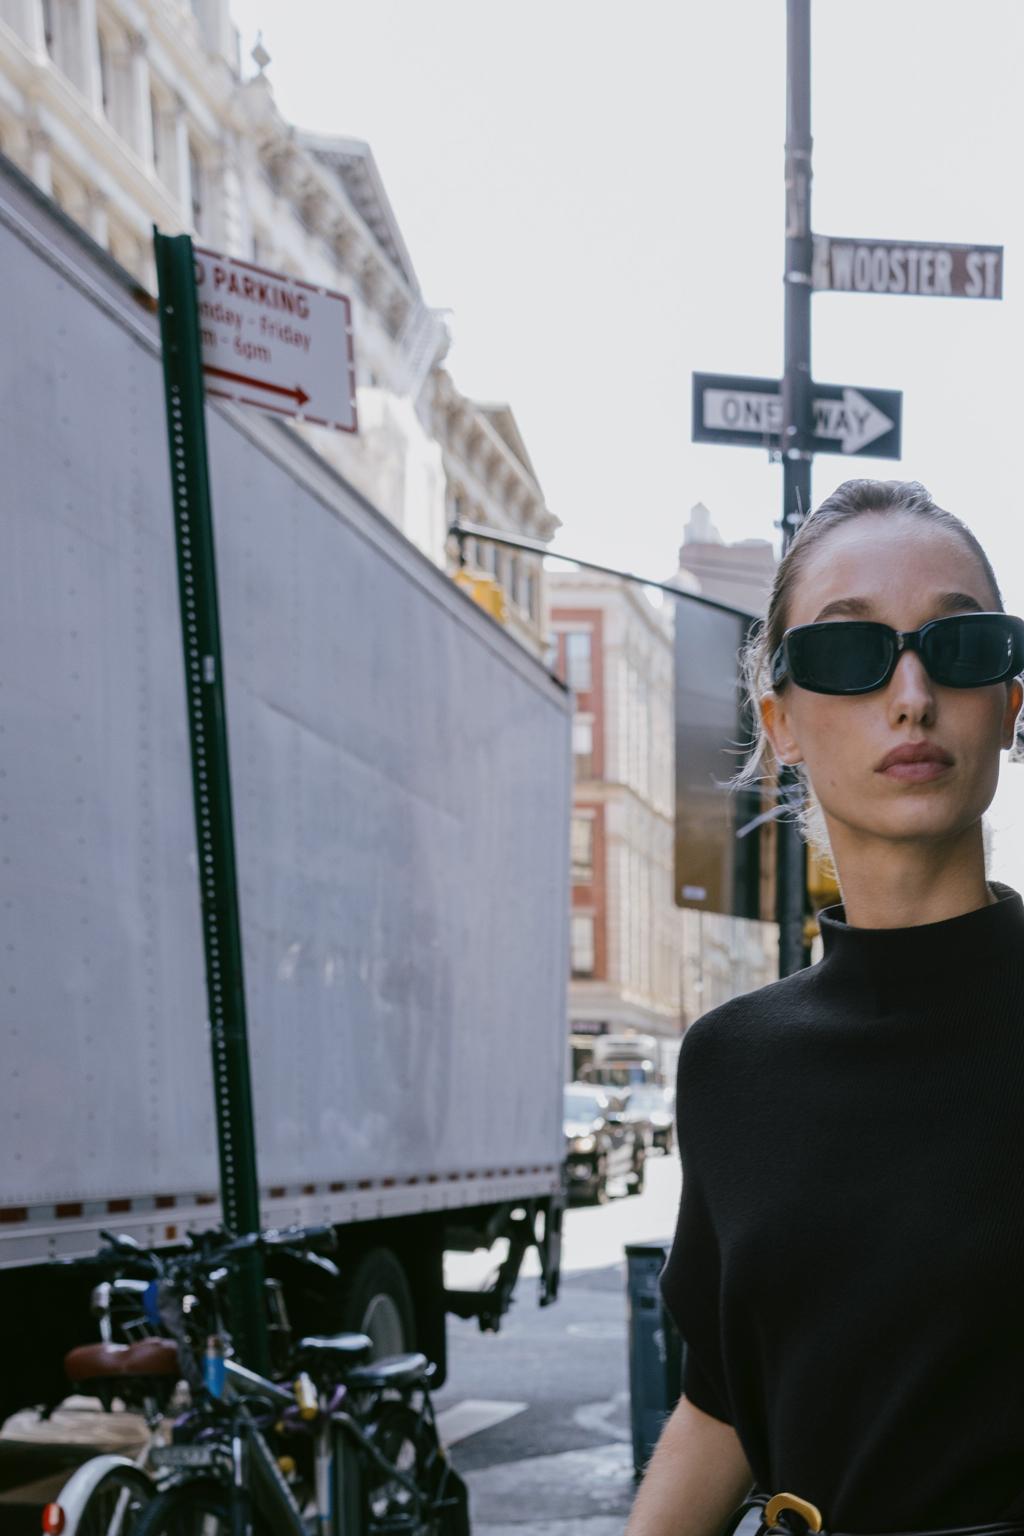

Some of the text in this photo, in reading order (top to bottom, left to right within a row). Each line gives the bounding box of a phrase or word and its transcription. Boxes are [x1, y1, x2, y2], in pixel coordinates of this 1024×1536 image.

[214, 266, 309, 318] PARKING
[830, 245, 998, 297] WOOSTER ST
[200, 303, 242, 329] nday
[261, 316, 310, 352] Friday
[234, 335, 272, 362] 6pm
[722, 398, 869, 434] ONE WAY
